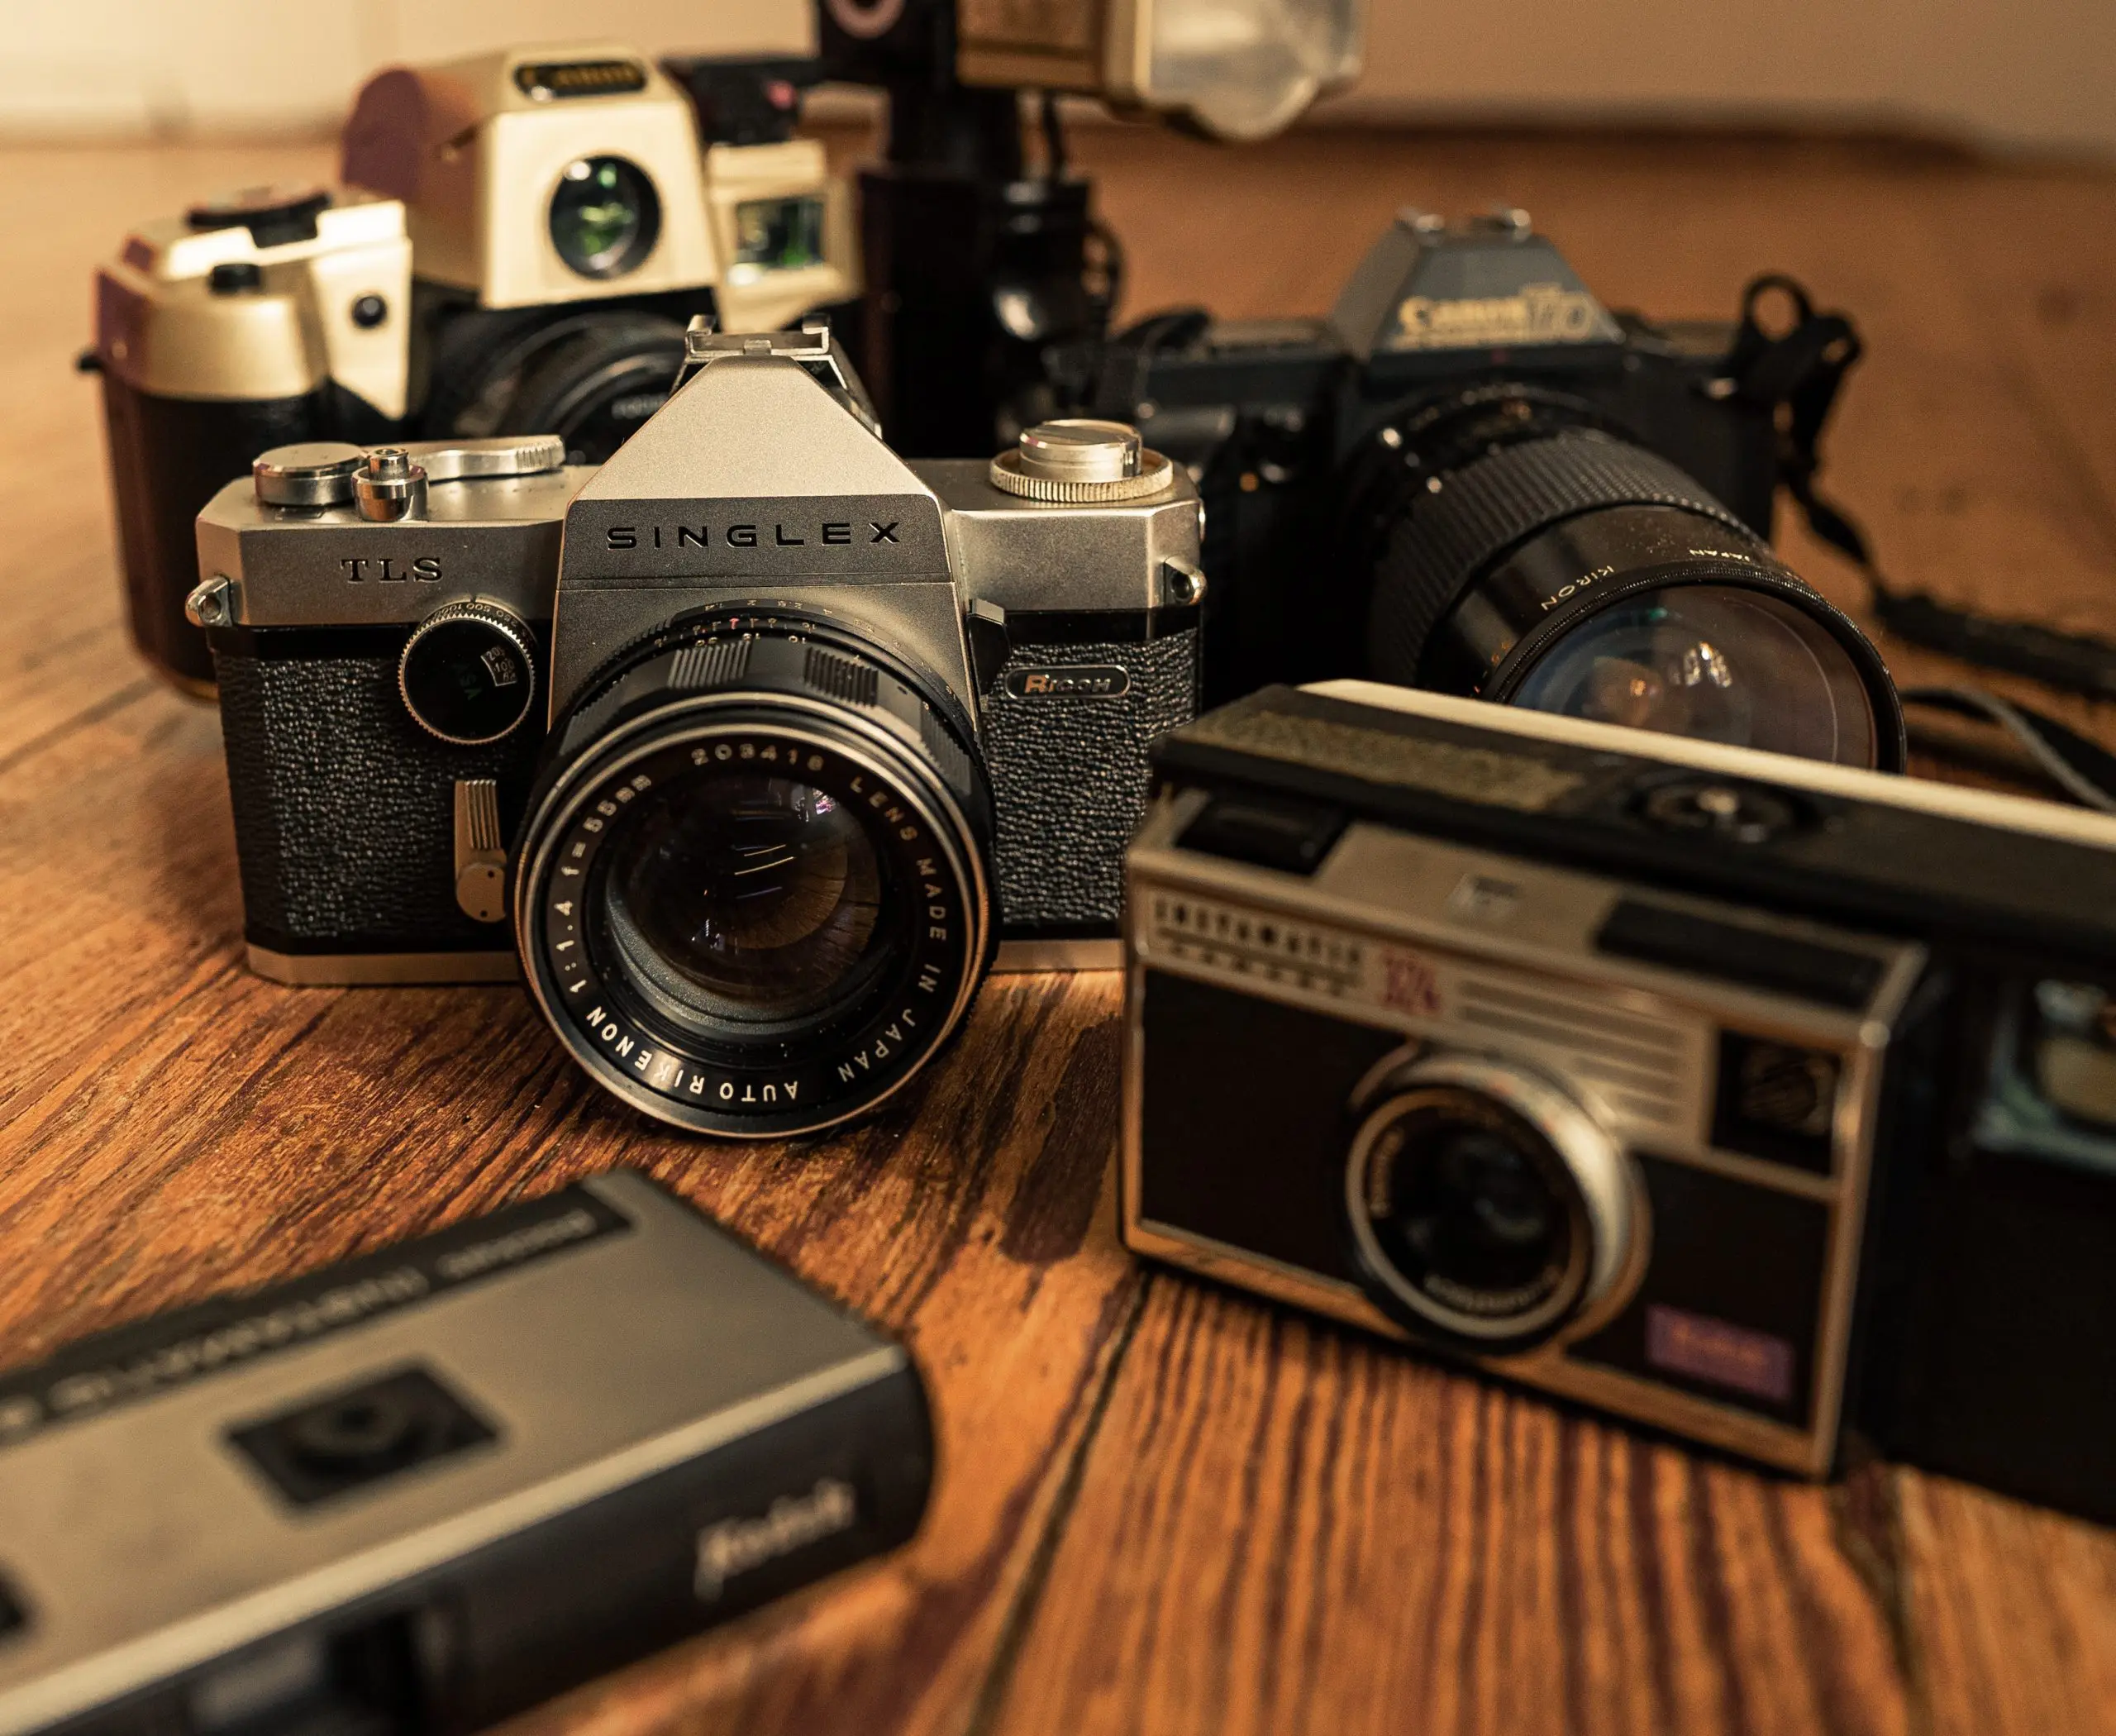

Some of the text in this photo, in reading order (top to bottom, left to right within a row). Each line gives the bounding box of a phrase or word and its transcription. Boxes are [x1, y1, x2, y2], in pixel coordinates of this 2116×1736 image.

[607, 522, 901, 550] SINGLEX
[340, 557, 443, 584] TLS
[1541, 565, 1614, 611] KIRON
[466, 603, 493, 613] 500
[495, 659, 515, 673] 100
[837, 775, 946, 1082] LENS MADE IN JAPAN
[554, 900, 587, 993] 1:1.4
[585, 1006, 704, 1095] RIKENON
[719, 1080, 798, 1102] AUTO
